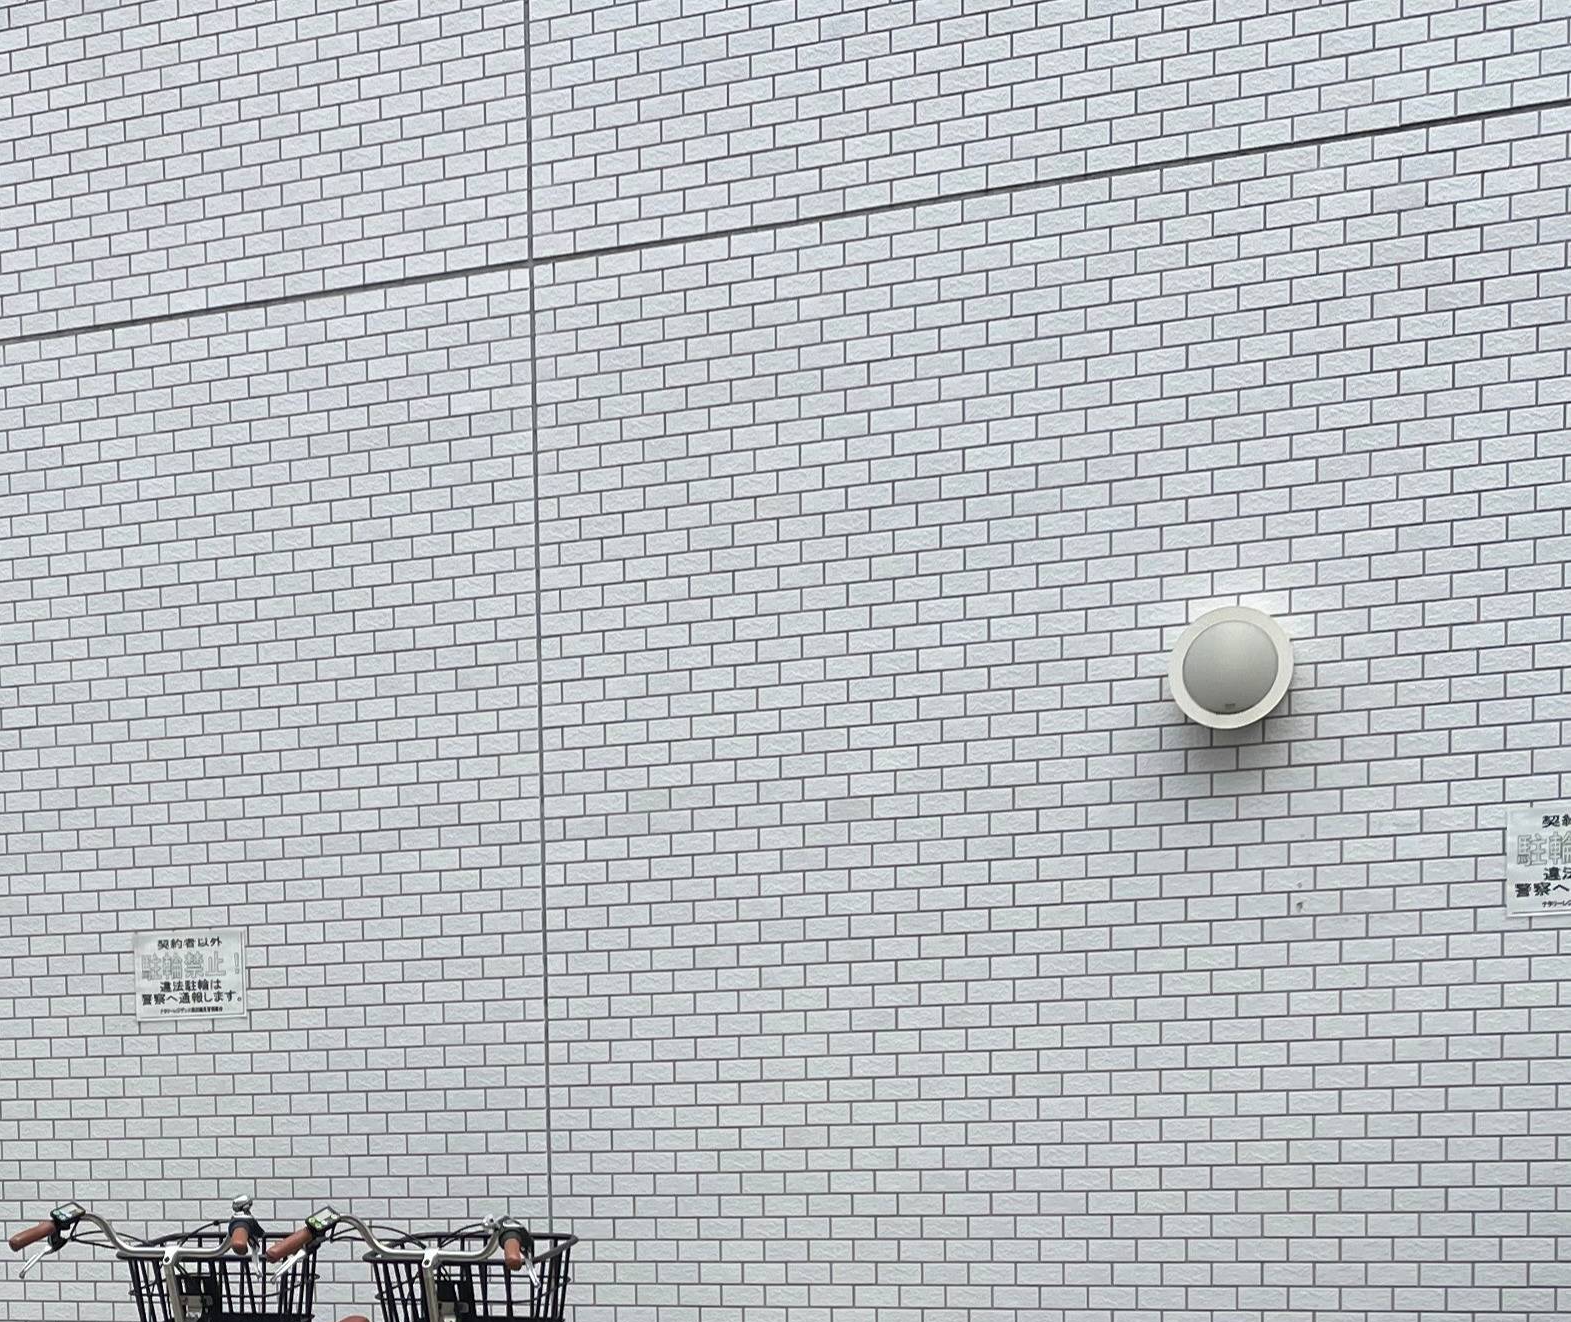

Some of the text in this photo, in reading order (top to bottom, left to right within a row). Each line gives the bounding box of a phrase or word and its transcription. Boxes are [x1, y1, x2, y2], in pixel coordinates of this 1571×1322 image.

[157, 936, 222, 950] 契約者以外
[160, 979, 222, 993] 違法駐輪は
[141, 990, 242, 1006] 警察へ通報します。
